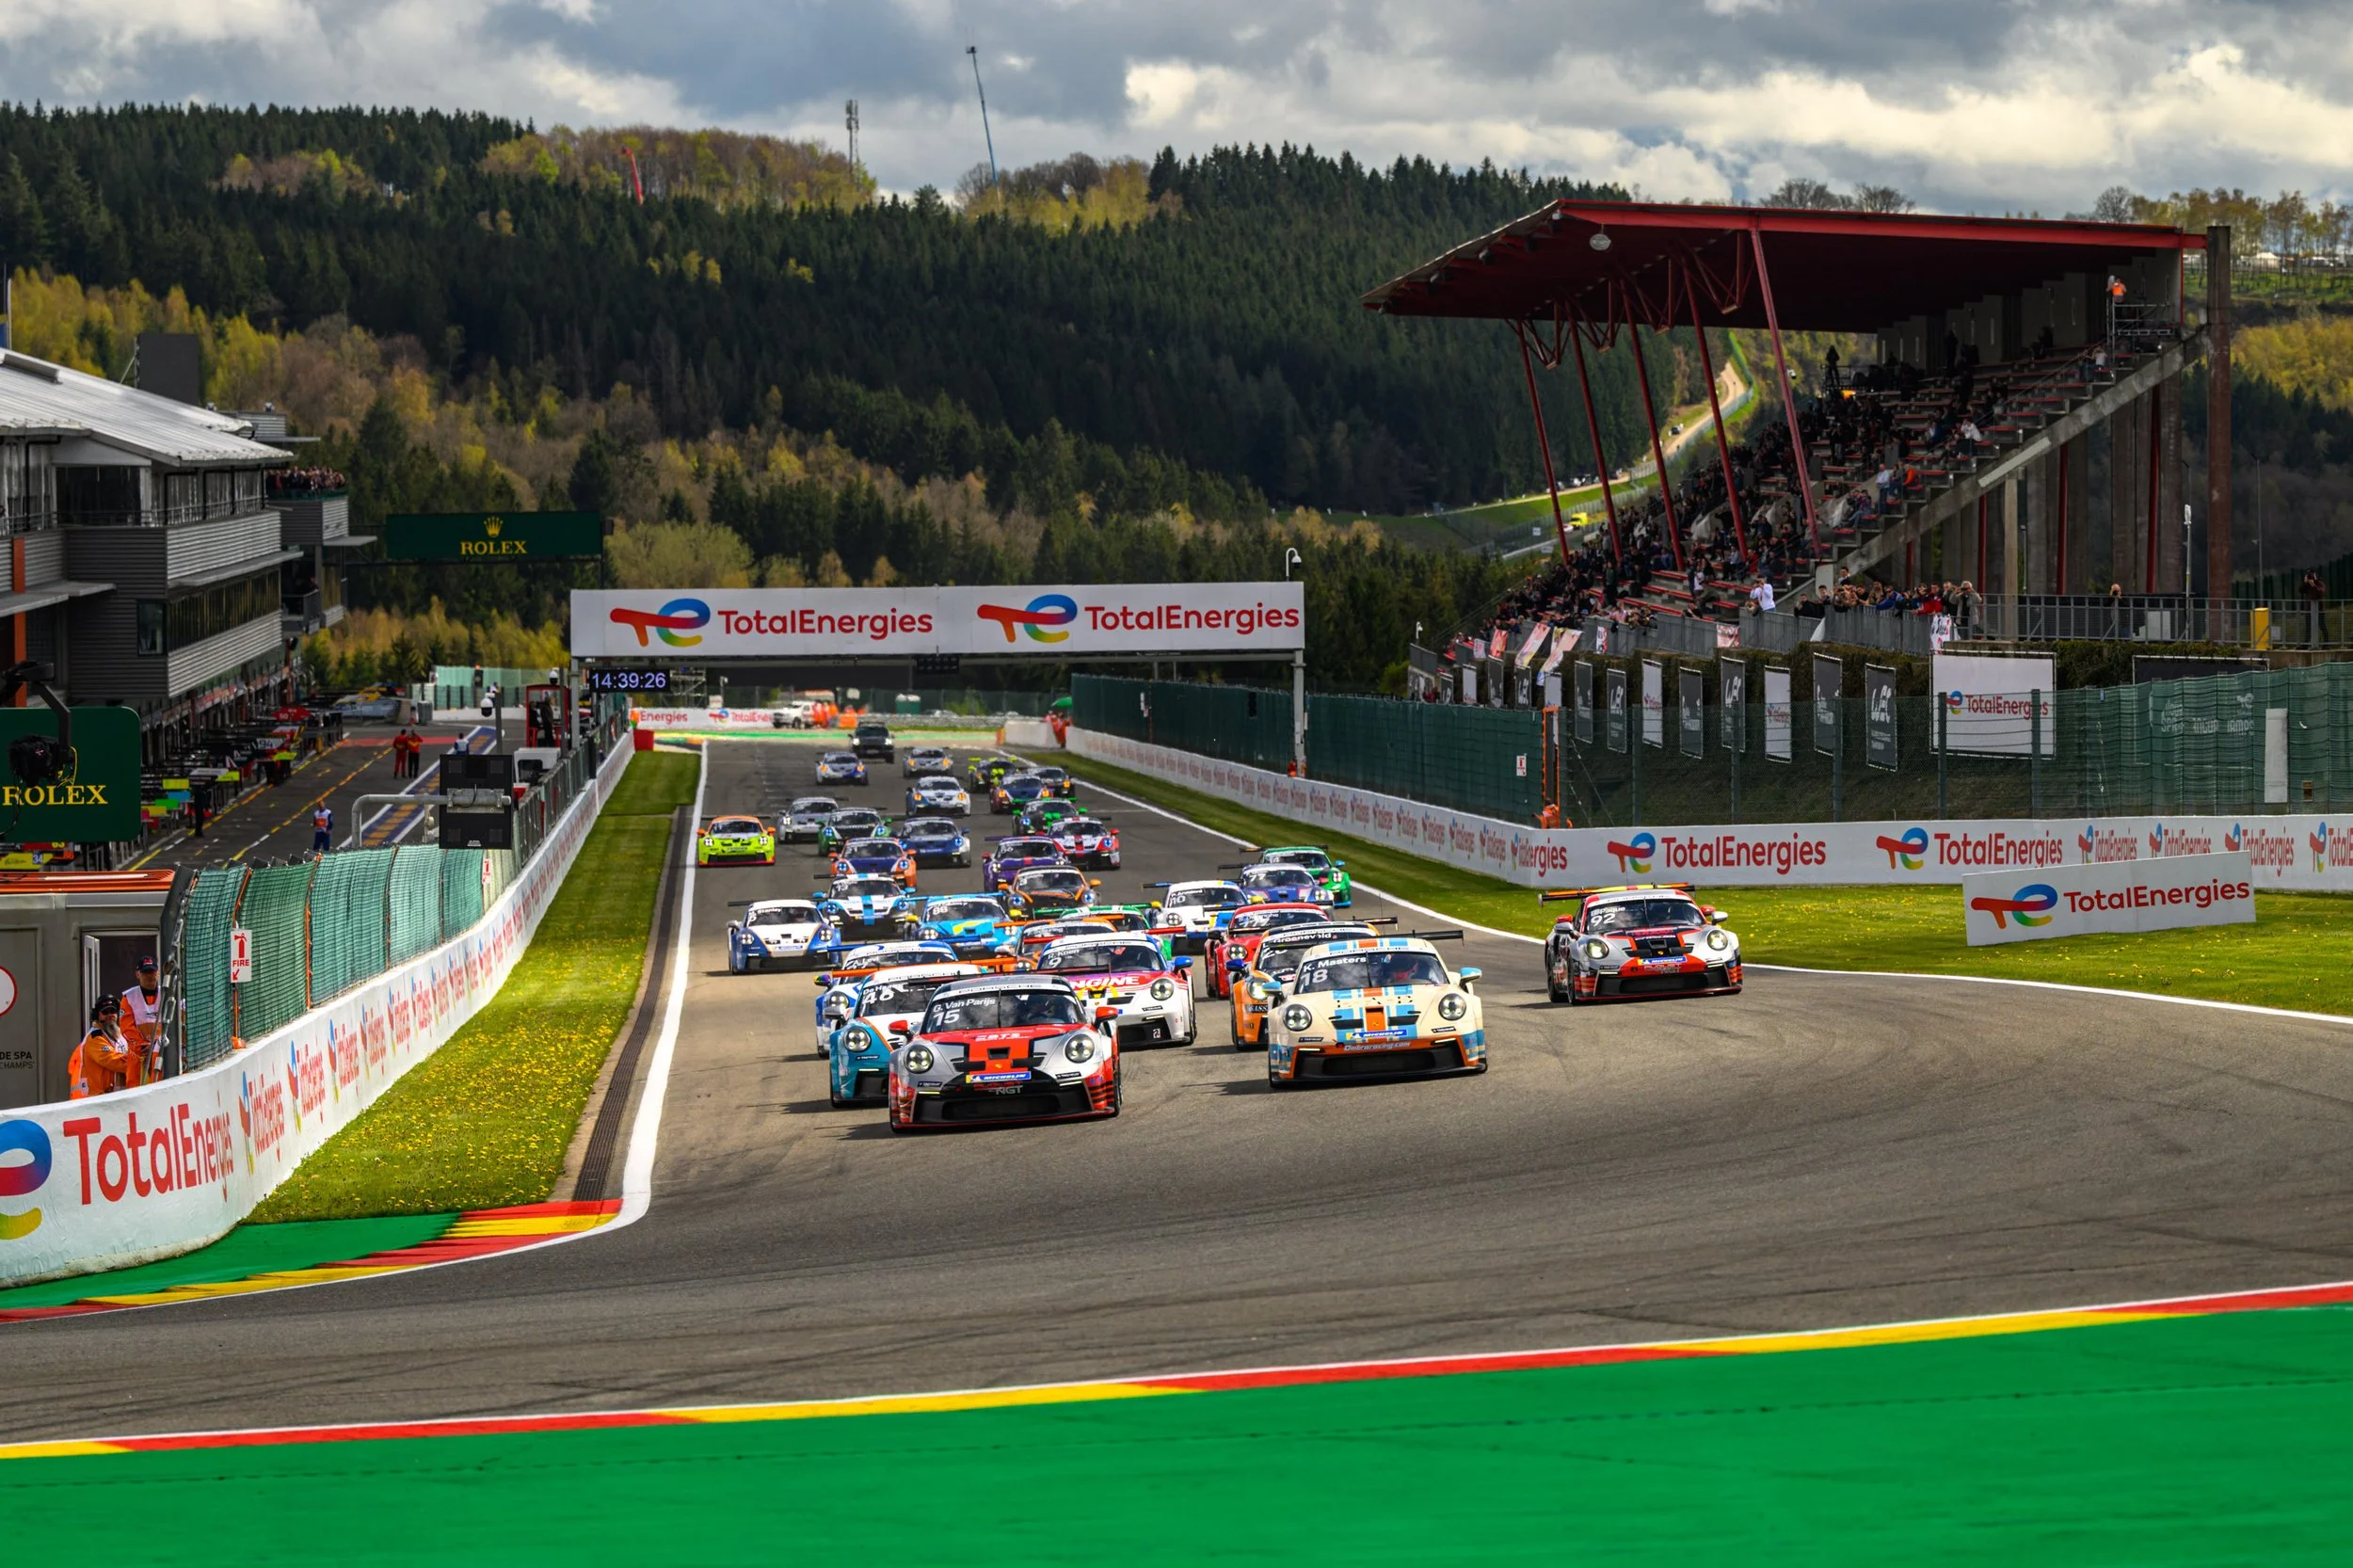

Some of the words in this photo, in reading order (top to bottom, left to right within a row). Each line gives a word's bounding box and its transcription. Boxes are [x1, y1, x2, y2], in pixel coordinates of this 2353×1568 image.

[460, 540, 527, 555] ROLEX
[717, 608, 933, 641] TotalEnergies
[1084, 602, 1300, 635] TotalEnergies
[592, 672, 666, 689] 14:39:26
[1965, 695, 2049, 721] TotalEnergs
[2, 784, 108, 807] ROLEX
[1661, 832, 1826, 875] TotalEnergies
[1934, 830, 2063, 868] TotalEnergies
[2063, 879, 2250, 913] TotalEnergies
[1591, 913, 1616, 927] 92
[232, 959, 249, 968] FIRE
[1048, 957, 1063, 968] 9
[1304, 964, 1315, 973] K.
[1318, 956, 1367, 968] Masters
[1301, 968, 1328, 987] 18
[934, 1004, 943, 1013] G.
[945, 1000, 965, 1010] Van
[933, 1009, 960, 1027] 15
[0, 1050, 11, 1061] DE
[13, 1050, 33, 1060] SPA
[63, 1090, 234, 1205] TotalEnergies
